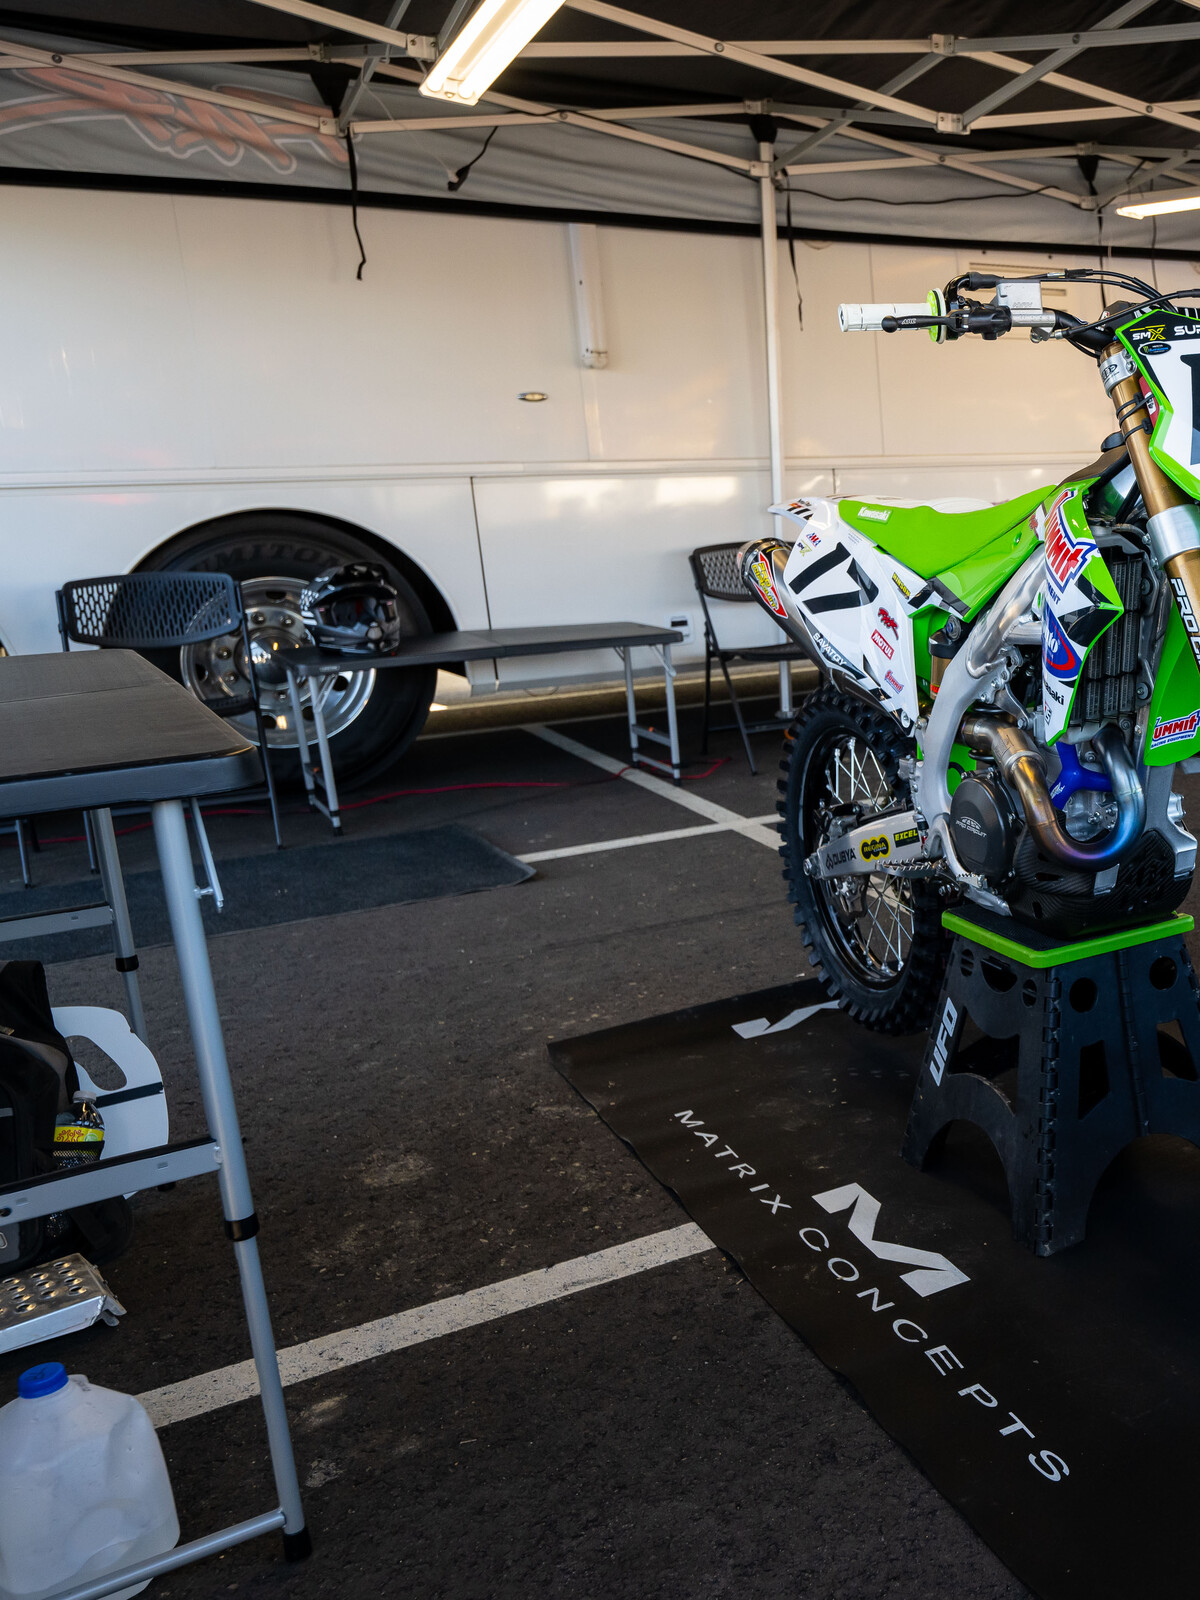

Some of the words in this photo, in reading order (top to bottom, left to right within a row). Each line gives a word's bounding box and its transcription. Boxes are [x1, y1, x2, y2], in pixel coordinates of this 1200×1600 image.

[1131, 327, 1166, 341] SMX
[857, 507, 892, 521] Kawasaki
[788, 541, 880, 615] 17
[1170, 577, 1200, 633] PRO
[872, 634, 894, 659] MOTUL
[863, 842, 886, 853] REGINA
[894, 829, 918, 842] EXCEL
[929, 996, 958, 1087] UFO
[674, 1109, 792, 1215] MATRIX
[799, 1227, 1070, 1482] CONCEPTS
